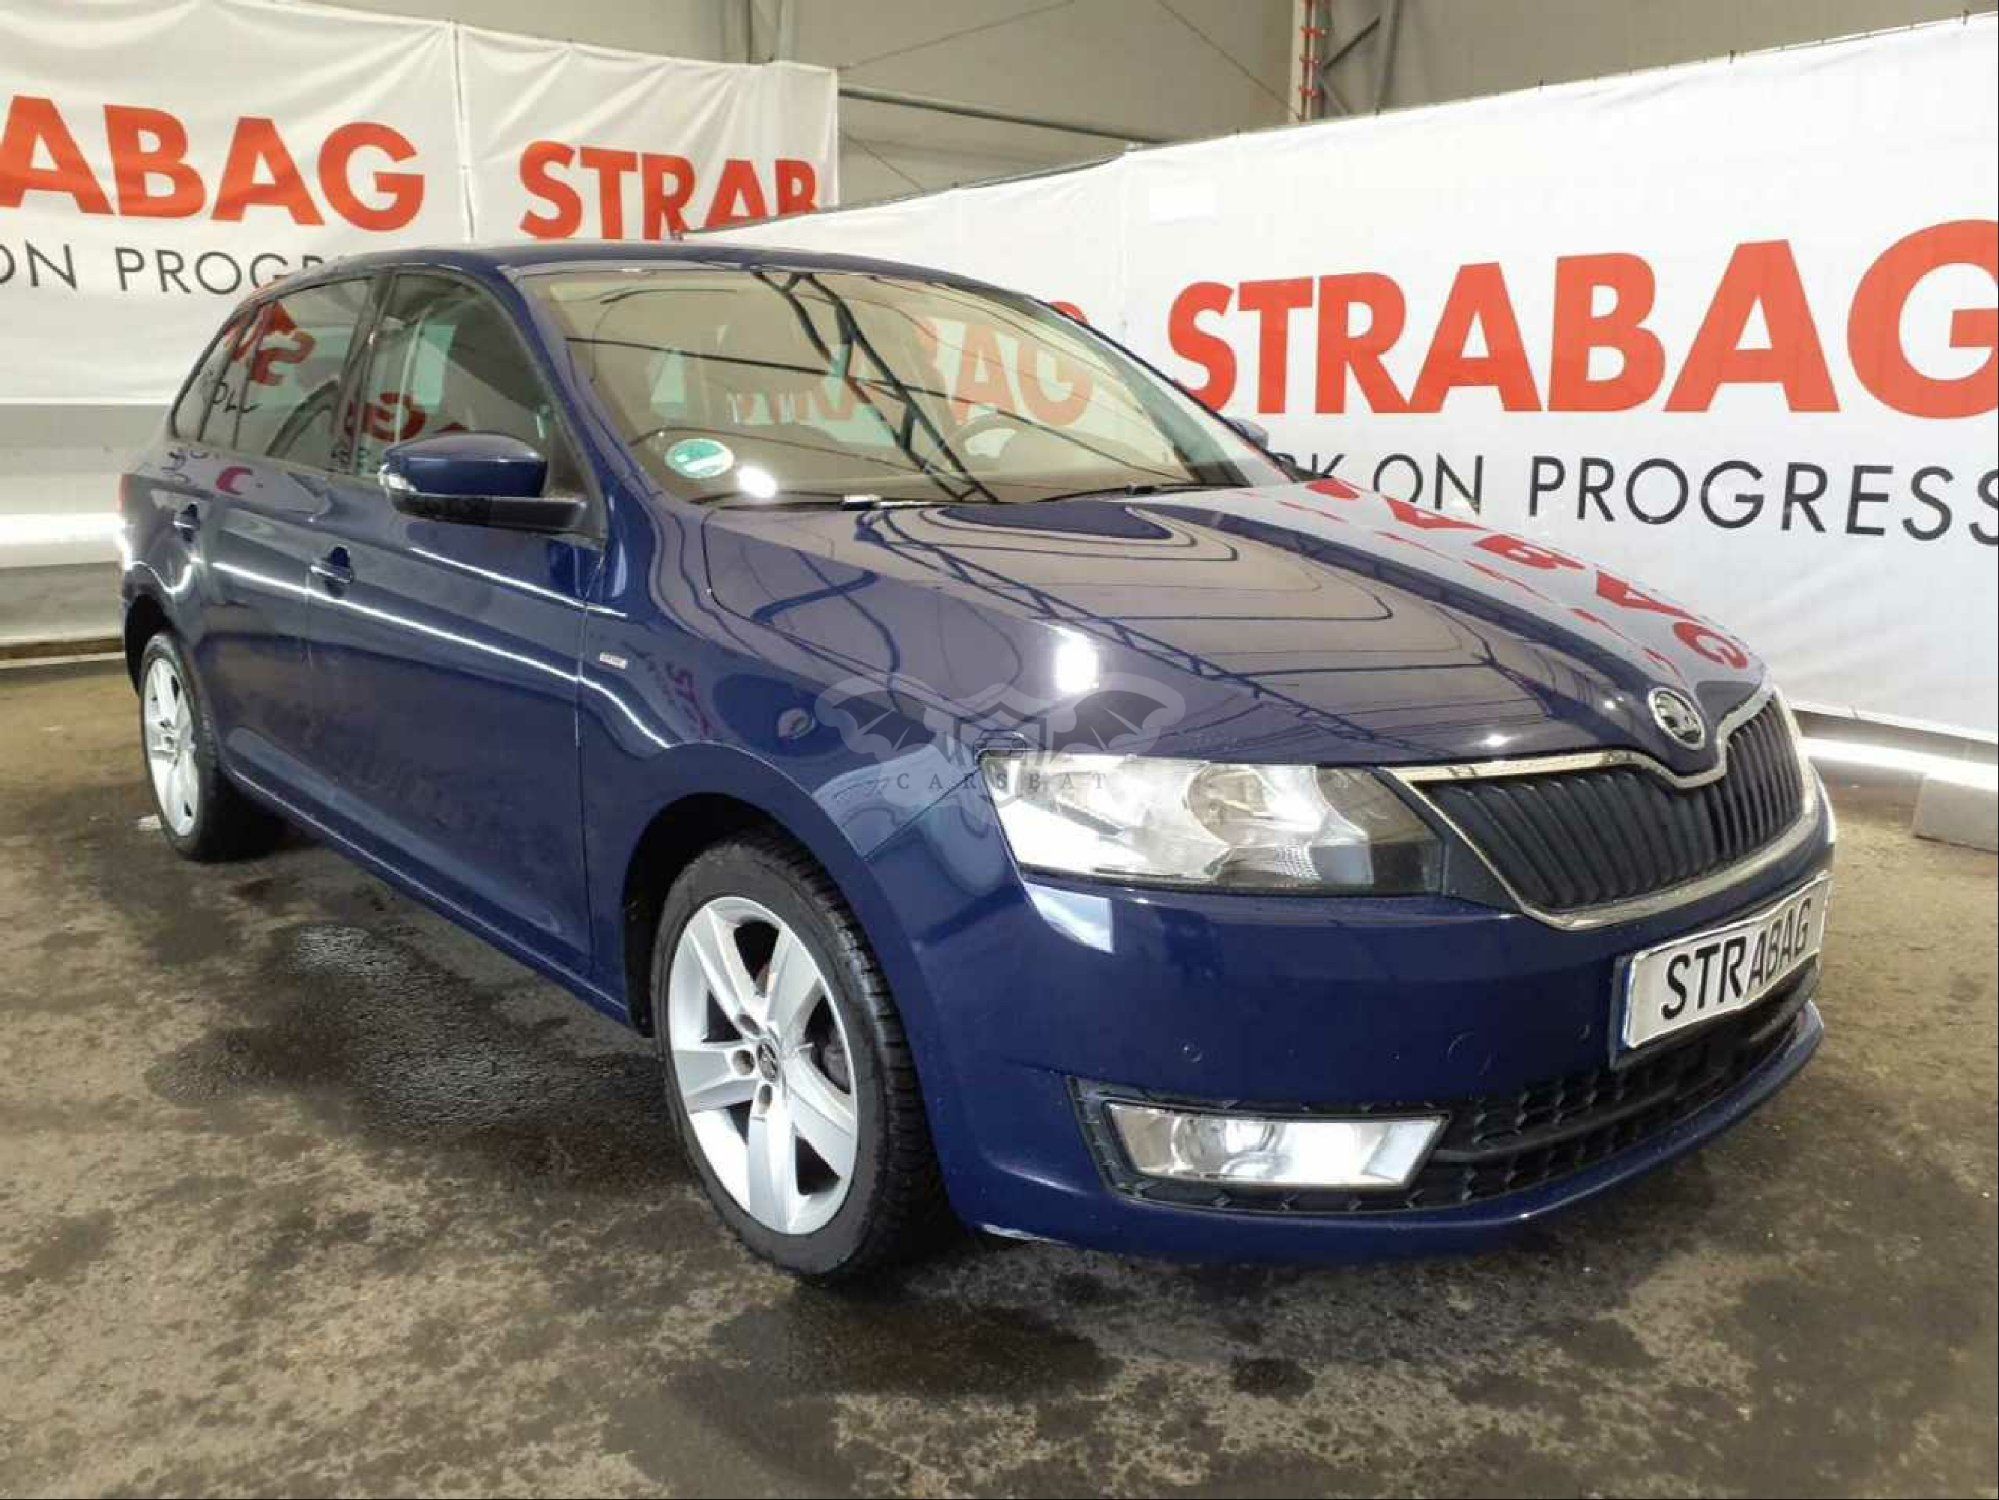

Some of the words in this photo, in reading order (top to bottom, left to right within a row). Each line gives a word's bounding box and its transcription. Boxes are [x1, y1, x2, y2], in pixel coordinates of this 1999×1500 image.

[0, 95, 425, 232] ABAG
[1167, 219, 1998, 419] STRABAG
[1373, 452, 1484, 515] ON
[1529, 455, 1998, 546] PROGRESS
[1660, 897, 1812, 1021] STRABAG
